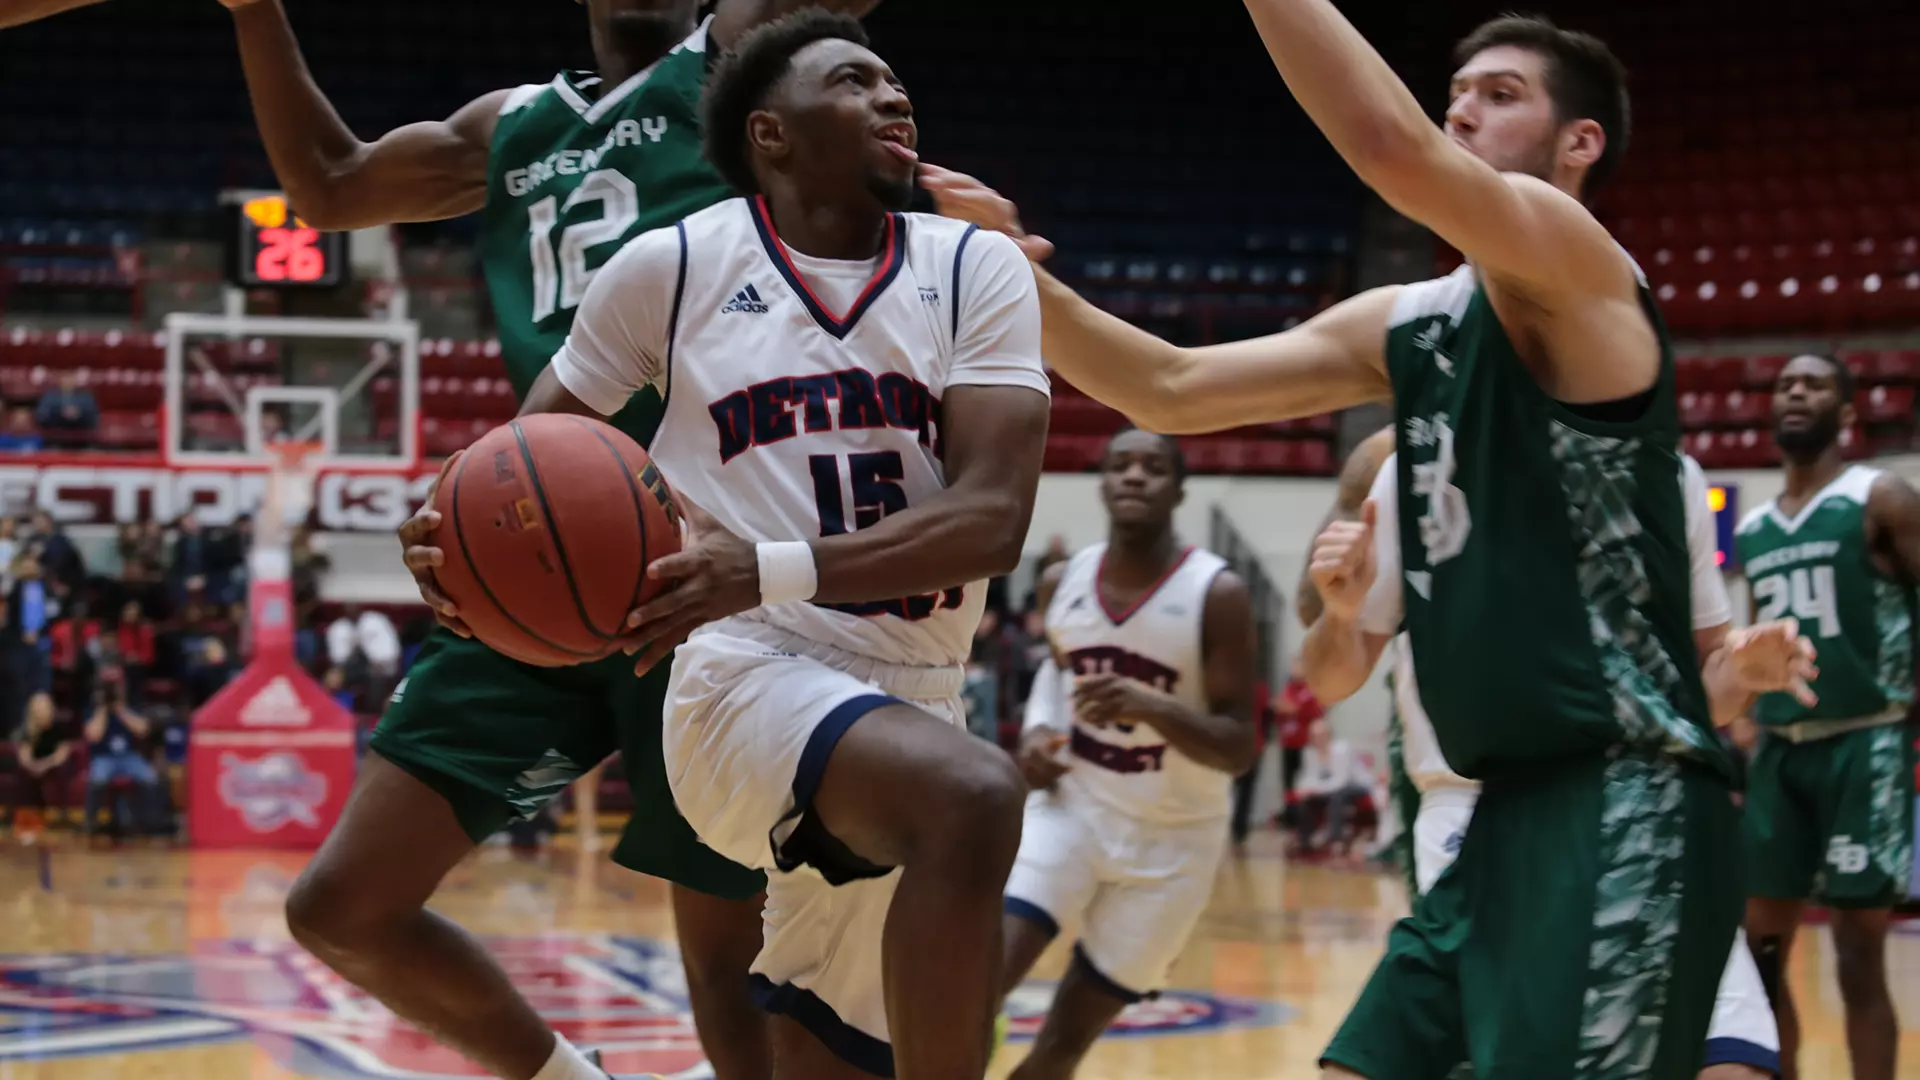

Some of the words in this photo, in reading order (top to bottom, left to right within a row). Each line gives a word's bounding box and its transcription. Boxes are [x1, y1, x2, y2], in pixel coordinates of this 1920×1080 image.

[255, 227, 325, 281] 26
[528, 167, 639, 323] 12
[721, 302, 768, 315] adidas
[808, 451, 908, 537] 15
[1753, 565, 1841, 638] 24
